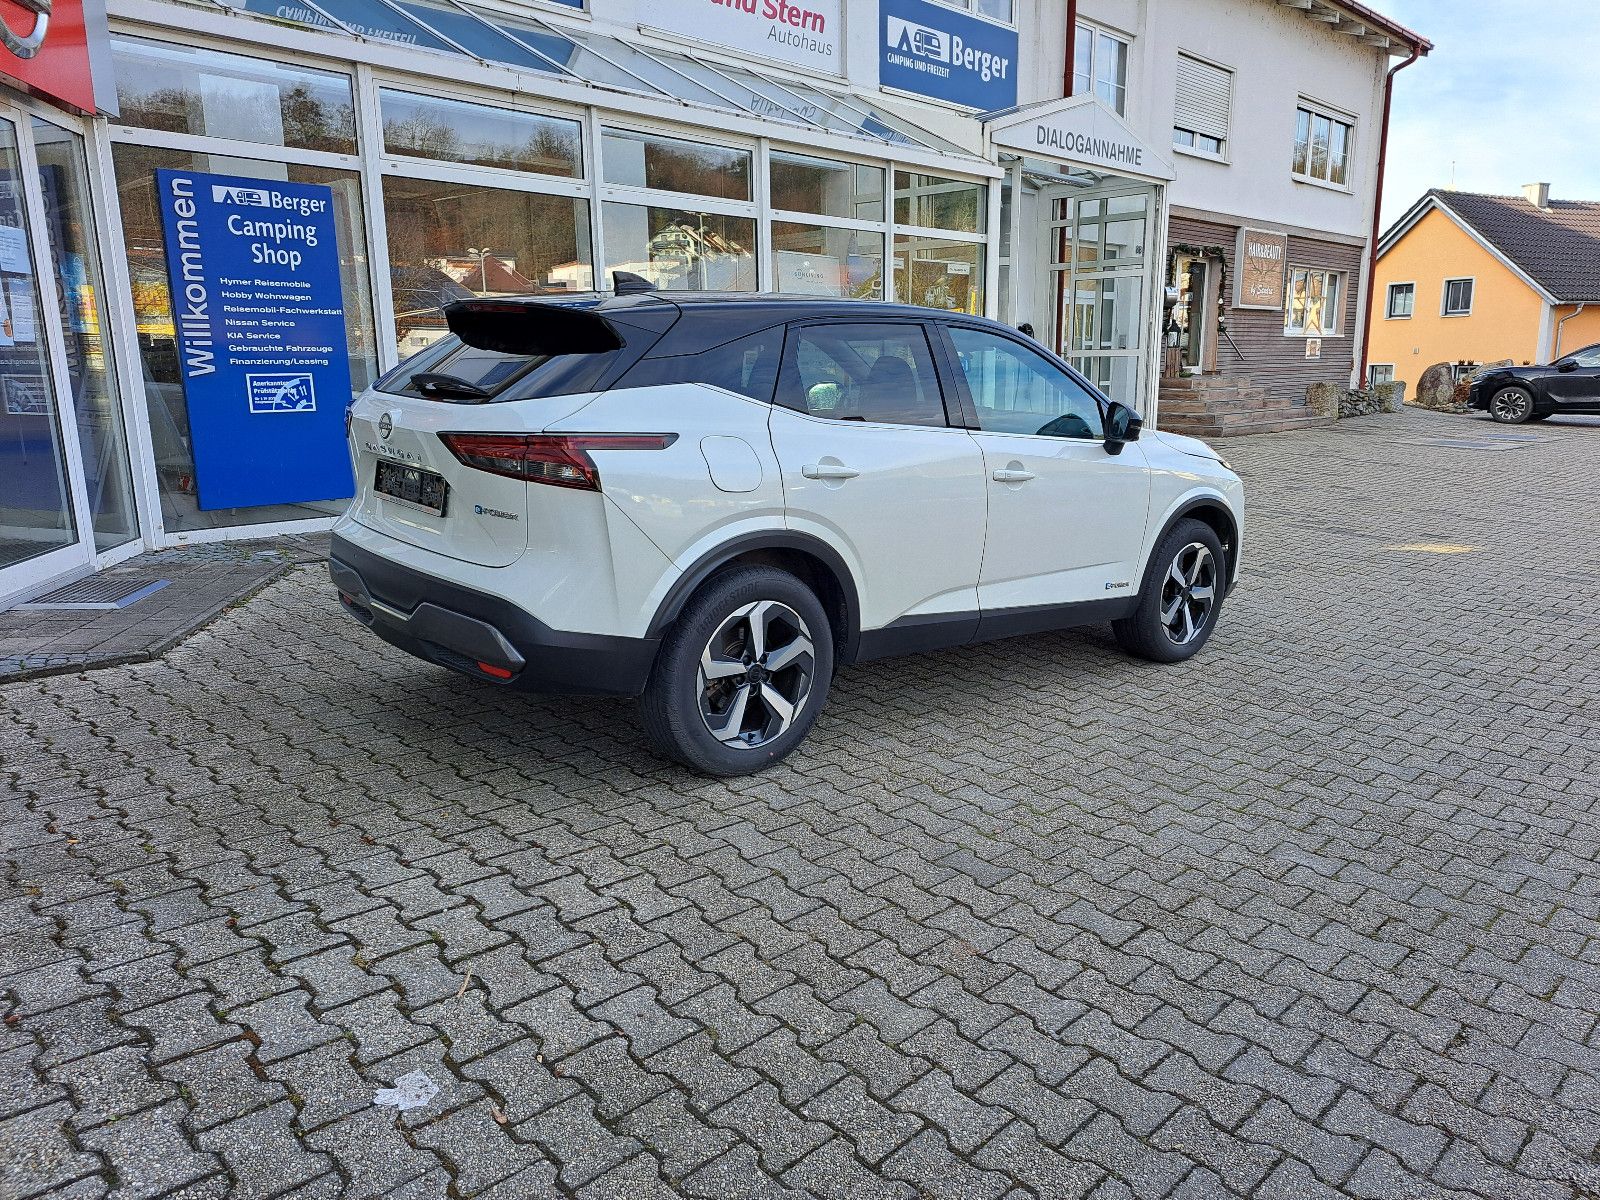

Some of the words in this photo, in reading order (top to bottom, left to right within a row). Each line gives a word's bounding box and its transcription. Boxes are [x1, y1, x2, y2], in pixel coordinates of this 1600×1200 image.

[762, 0, 825, 34] Stern
[767, 25, 832, 56] Autohaus
[887, 52, 914, 69] CAMPING
[914, 60, 927, 72] UND
[927, 64, 950, 79] FREIZEIT
[952, 35, 1009, 82] Berger
[1036, 124, 1143, 166] DIALOGANNAHME
[271, 191, 326, 216] Berger
[227, 214, 318, 247] Camping
[251, 242, 302, 271] Shop
[171, 177, 216, 377] Willkommen
[219, 277, 252, 287] Hymer
[254, 279, 311, 289] Reisemobile
[221, 290, 253, 300] Hobby
[255, 292, 312, 302] Wohnwagen
[223, 305, 343, 316] Reisemobil-Fachwerkstatt
[225, 318, 259, 326] Nissan
[261, 319, 296, 328] Service
[227, 331, 244, 339] KIA
[246, 332, 281, 340] Service
[228, 344, 284, 353] Gebrauchte
[285, 345, 333, 354] Fahrzeuge
[230, 357, 329, 366] Finanzierung/Leasing
